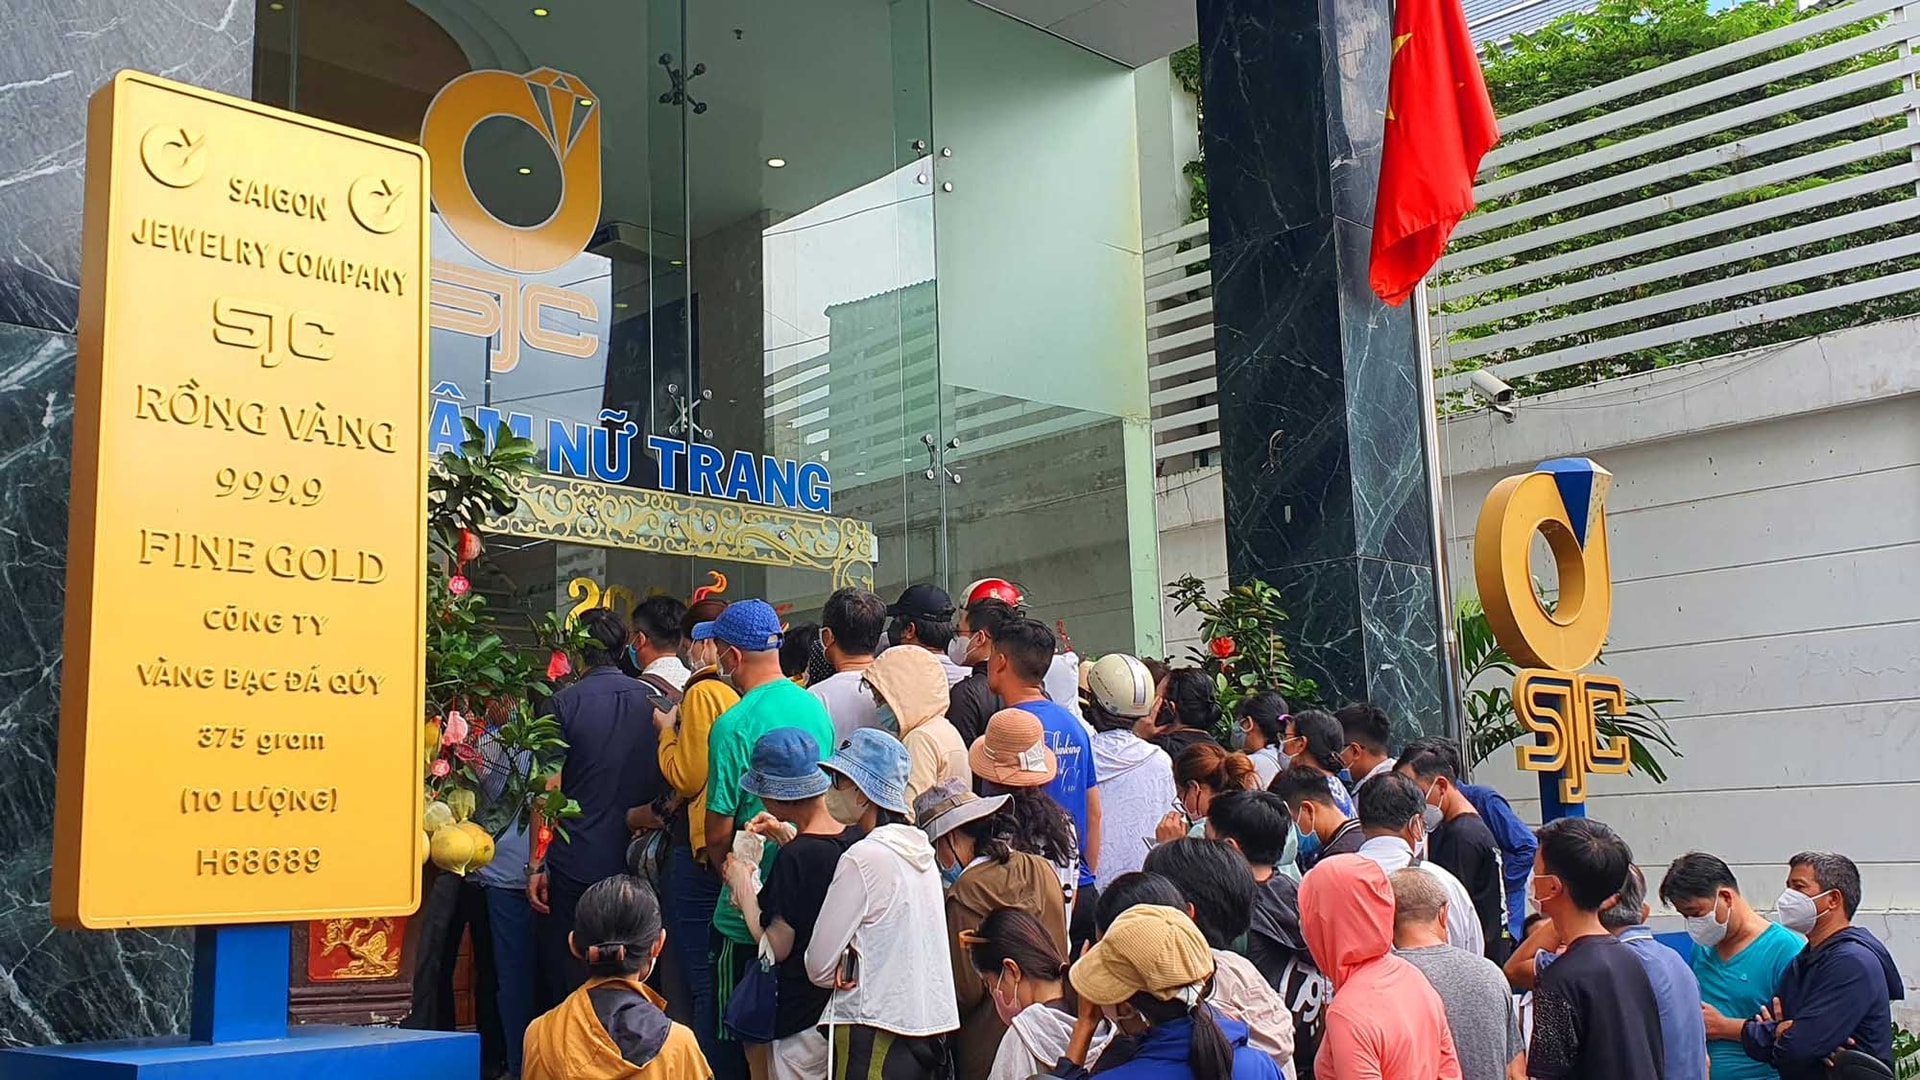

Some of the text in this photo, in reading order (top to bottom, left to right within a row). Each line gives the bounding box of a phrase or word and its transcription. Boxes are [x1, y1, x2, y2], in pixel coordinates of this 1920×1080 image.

[228, 175, 327, 222] SAIGON
[131, 218, 407, 296] JEWELRY COMPANY
[212, 296, 337, 369] SJC
[135, 378, 398, 454] RỒNG VÀNG
[546, 408, 639, 484] NỮ
[647, 434, 832, 514] TRANG
[215, 466, 325, 507] 999.9
[138, 529, 386, 585] FINE GOLD
[292, 613, 329, 636] TY
[136, 656, 217, 690] VÀNG
[223, 667, 280, 698] BẠC
[284, 664, 321, 694] ĐÁ
[197, 725, 325, 755] 375 gram
[1512, 668, 1631, 804] SJC
[180, 787, 222, 814] (10
[196, 847, 322, 877] H68689
